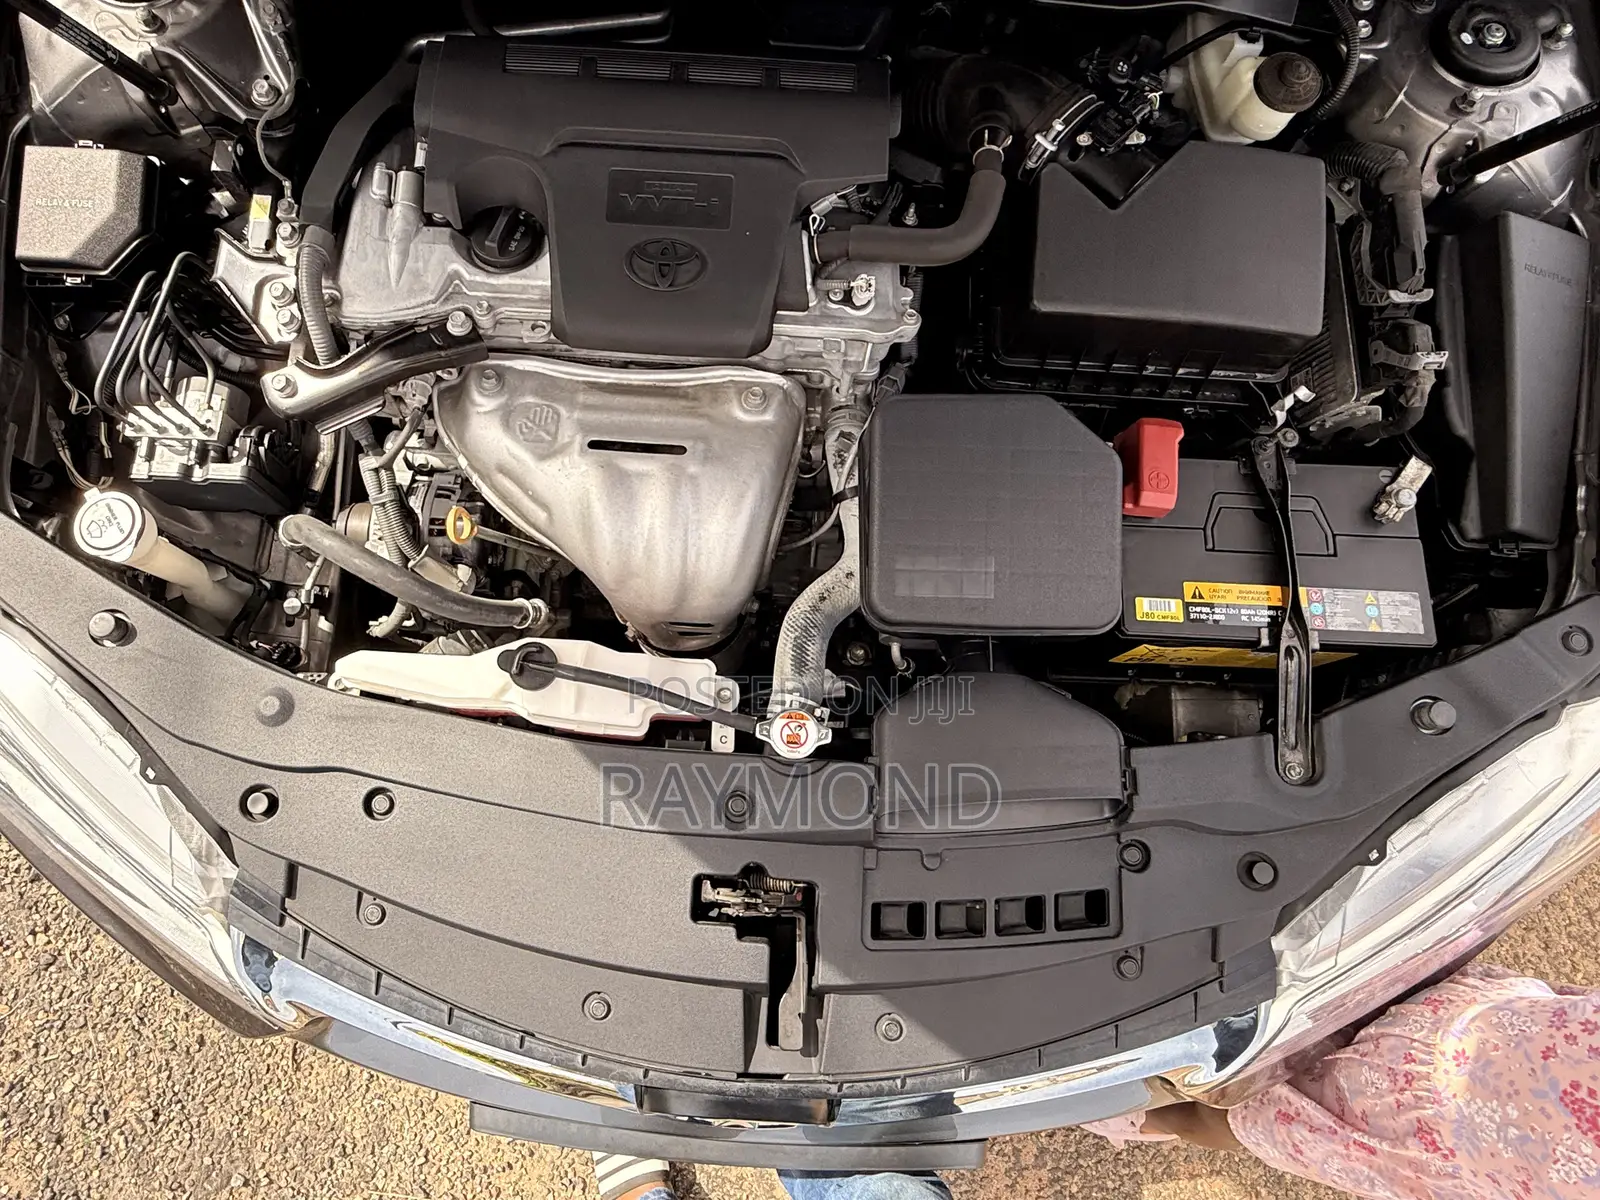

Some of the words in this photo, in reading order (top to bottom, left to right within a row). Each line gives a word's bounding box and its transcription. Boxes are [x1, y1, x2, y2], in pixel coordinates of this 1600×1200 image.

[35, 197, 62, 207] RELAY
[71, 199, 94, 208] FUSE
[1208, 587, 1233, 595] CAUTION
[1139, 611, 1156, 620] J80
